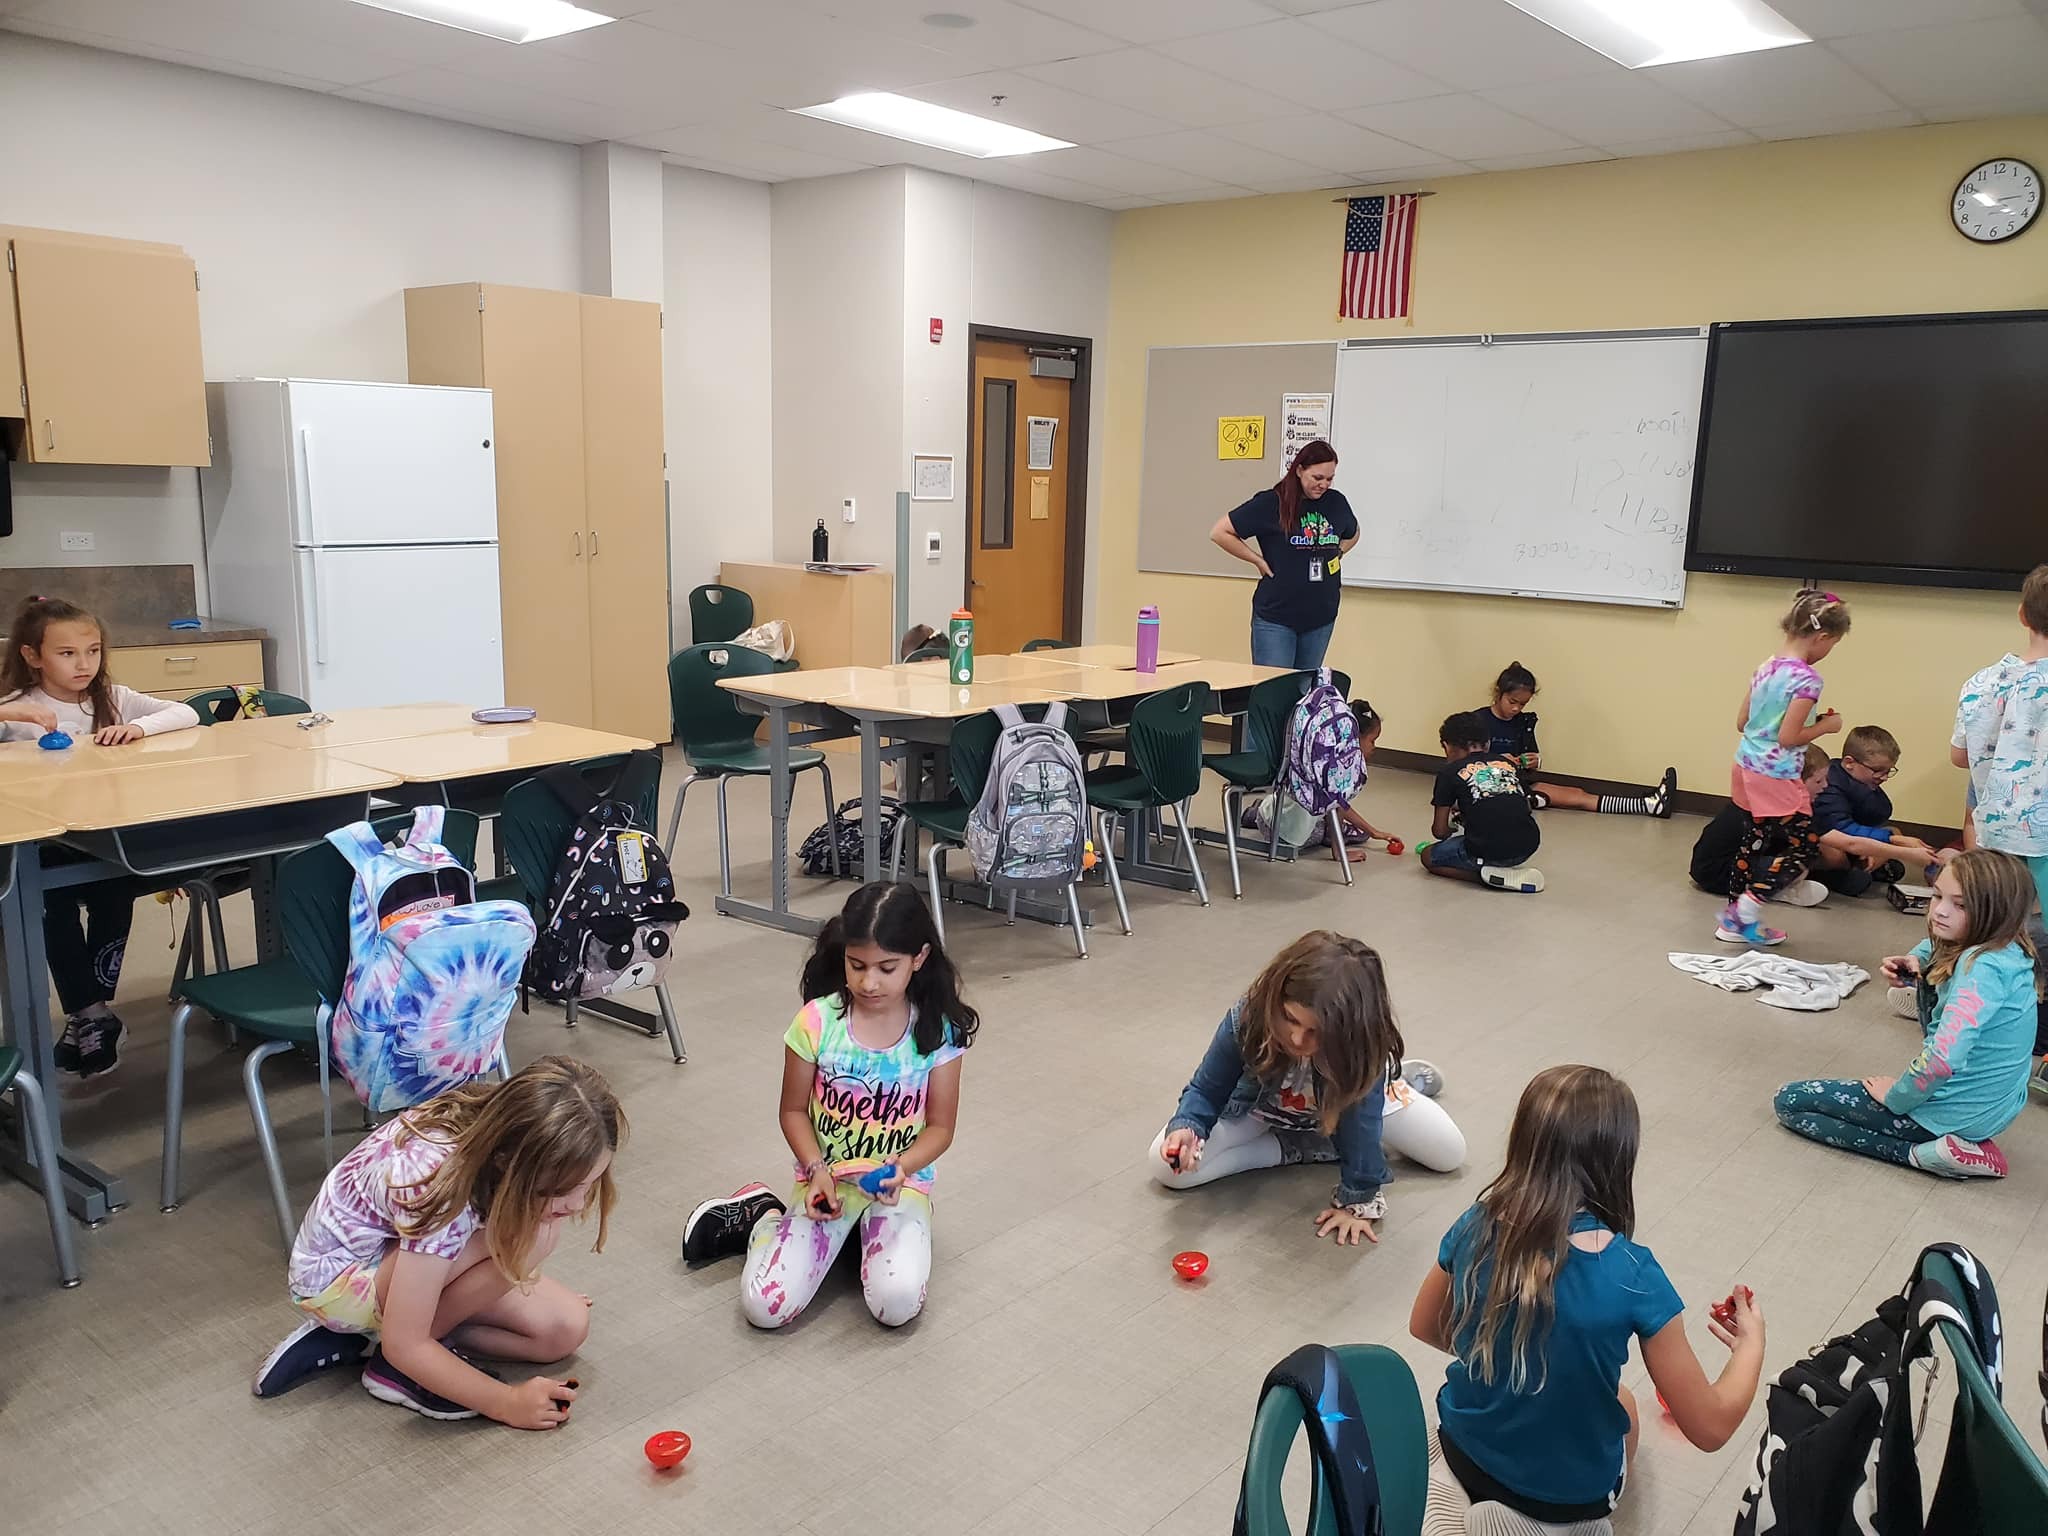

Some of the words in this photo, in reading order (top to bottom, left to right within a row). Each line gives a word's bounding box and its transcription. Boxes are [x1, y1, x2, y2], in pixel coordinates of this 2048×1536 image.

[1993, 162, 2007, 175] 12
[1978, 170, 1988, 181] 11
[2023, 176, 2033, 188] 2
[1962, 182, 1975, 195] 10
[2027, 191, 2036, 203] 3
[1957, 199, 1966, 211] 9
[2020, 207, 2029, 218] 4
[1960, 213, 1969, 225] 8
[1973, 223, 1983, 236] 7
[1989, 225, 1999, 238] 6
[2006, 220, 2015, 232] 5
[818, 1112, 842, 1138] we
[838, 1121, 918, 1161] shine
